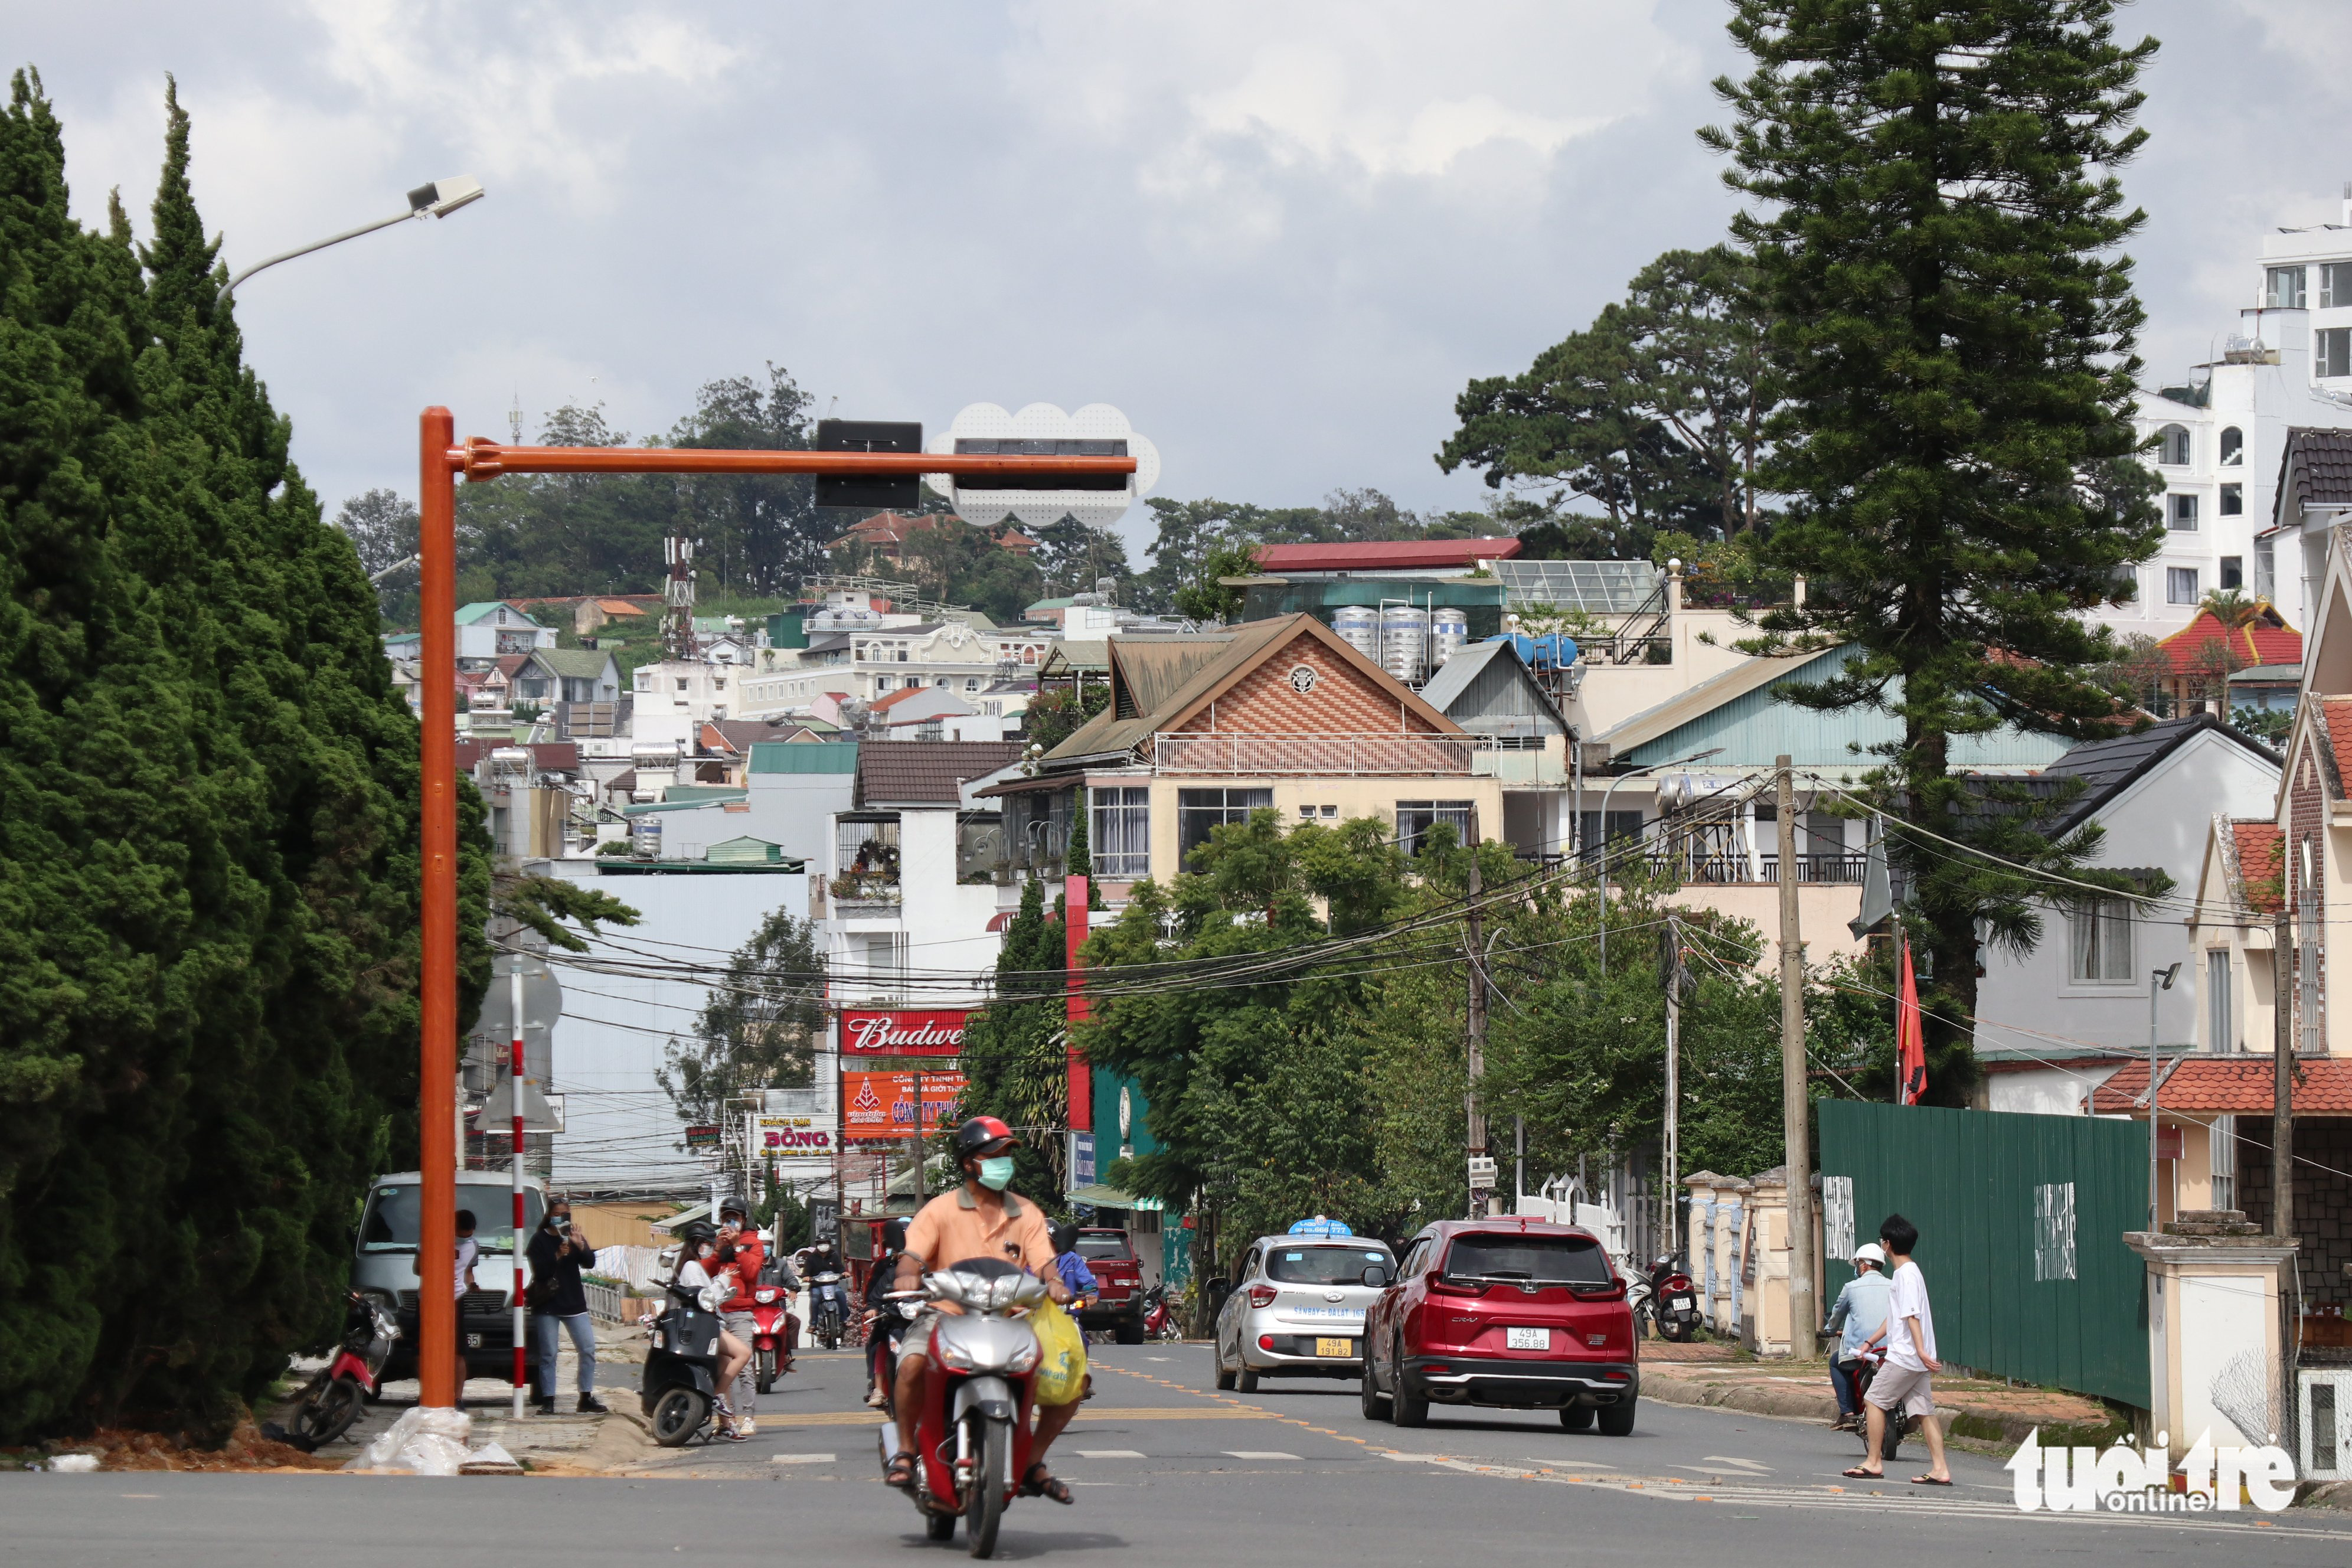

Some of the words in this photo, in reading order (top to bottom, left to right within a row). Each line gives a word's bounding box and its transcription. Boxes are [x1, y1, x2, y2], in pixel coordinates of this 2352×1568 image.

[922, 1101, 935, 1122] TY
[759, 1117, 790, 1126] KHÁCH
[793, 1118, 811, 1128] SẠN
[764, 1128, 829, 1146] BÔNG
[1520, 1329, 1537, 1338] 49A
[1512, 1339, 1545, 1348] 356.88
